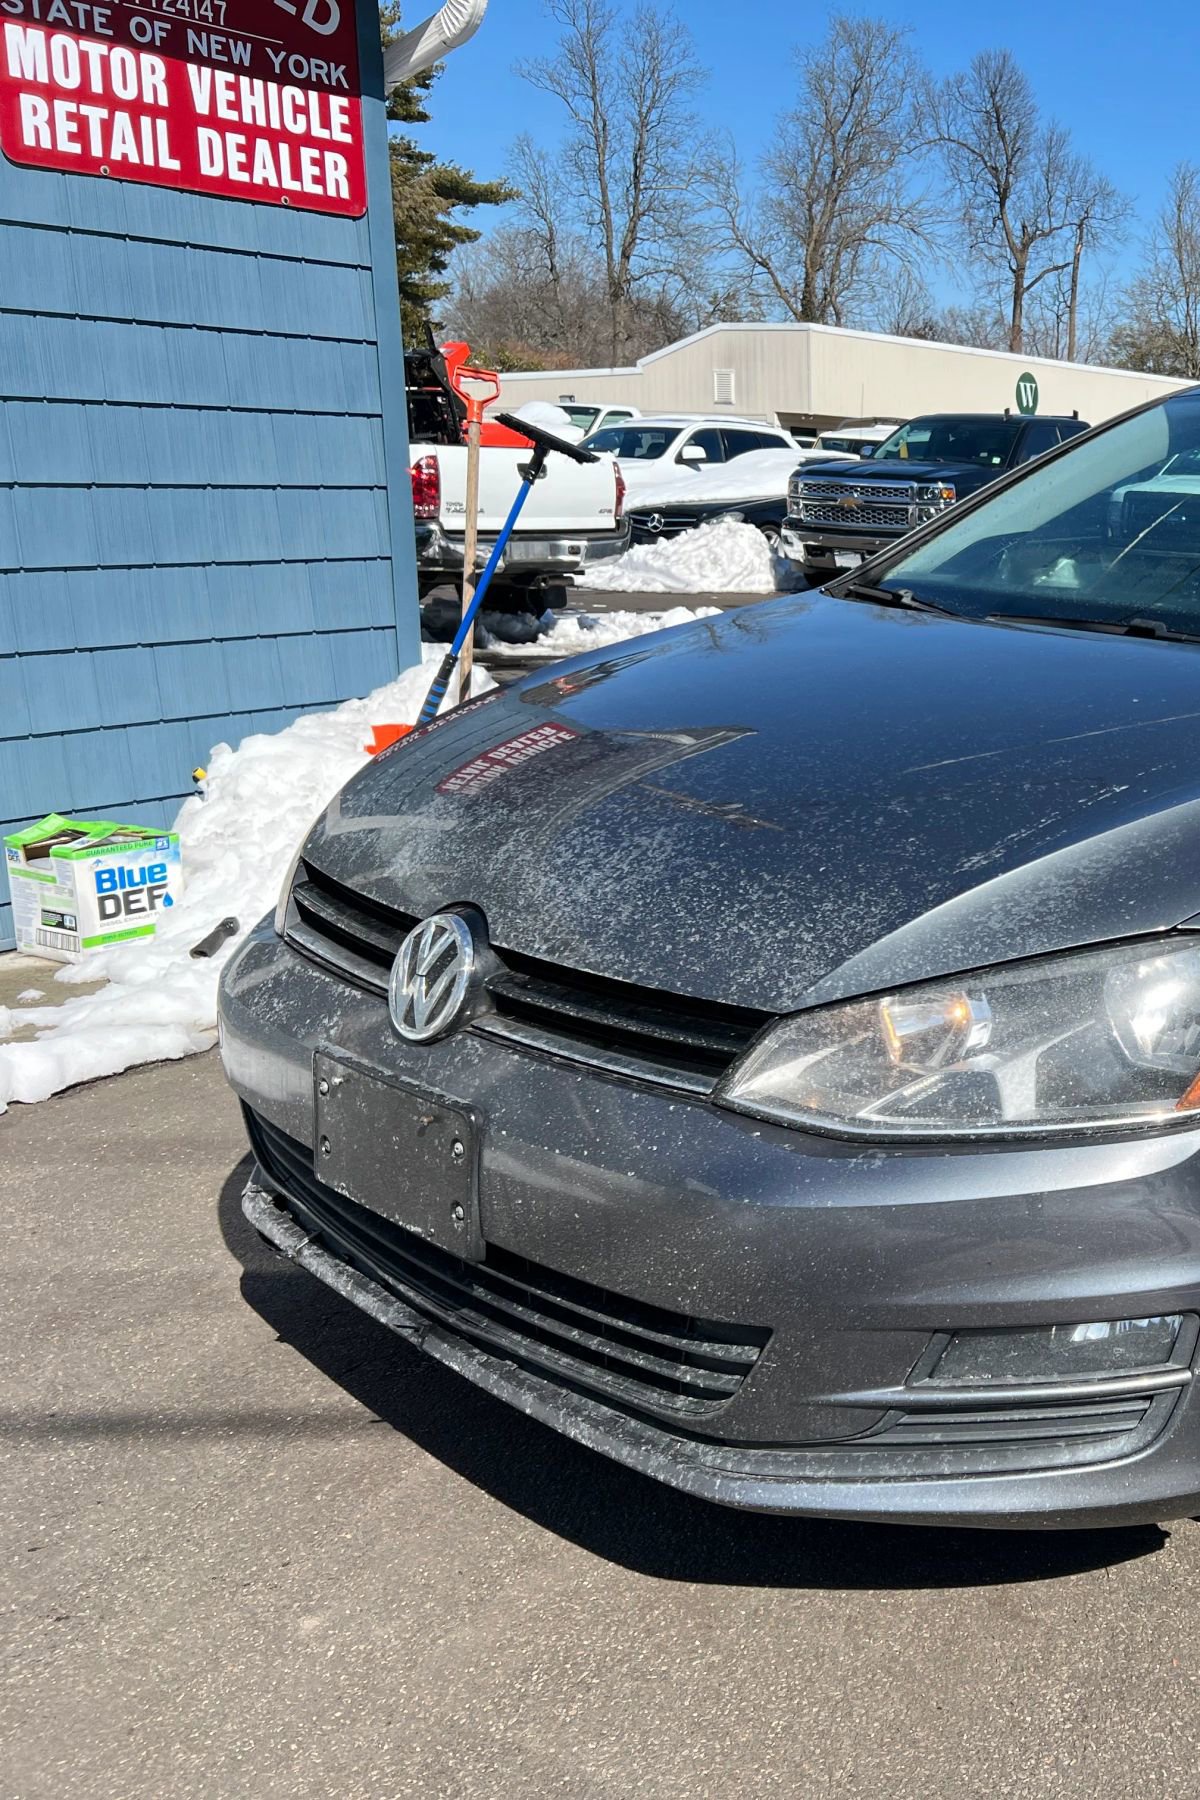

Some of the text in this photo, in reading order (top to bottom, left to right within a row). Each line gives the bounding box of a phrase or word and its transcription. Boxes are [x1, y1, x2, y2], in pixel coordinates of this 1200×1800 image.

[129, 16, 171, 46] OF
[187, 28, 252, 67] NEW
[265, 47, 349, 89] YORK
[3, 22, 352, 144] MOTOR VEHICLE
[19, 92, 350, 200] RETAIL DEALER
[1018, 381, 1036, 408] W
[95, 863, 168, 894] Blue
[97, 882, 168, 921] DEF
